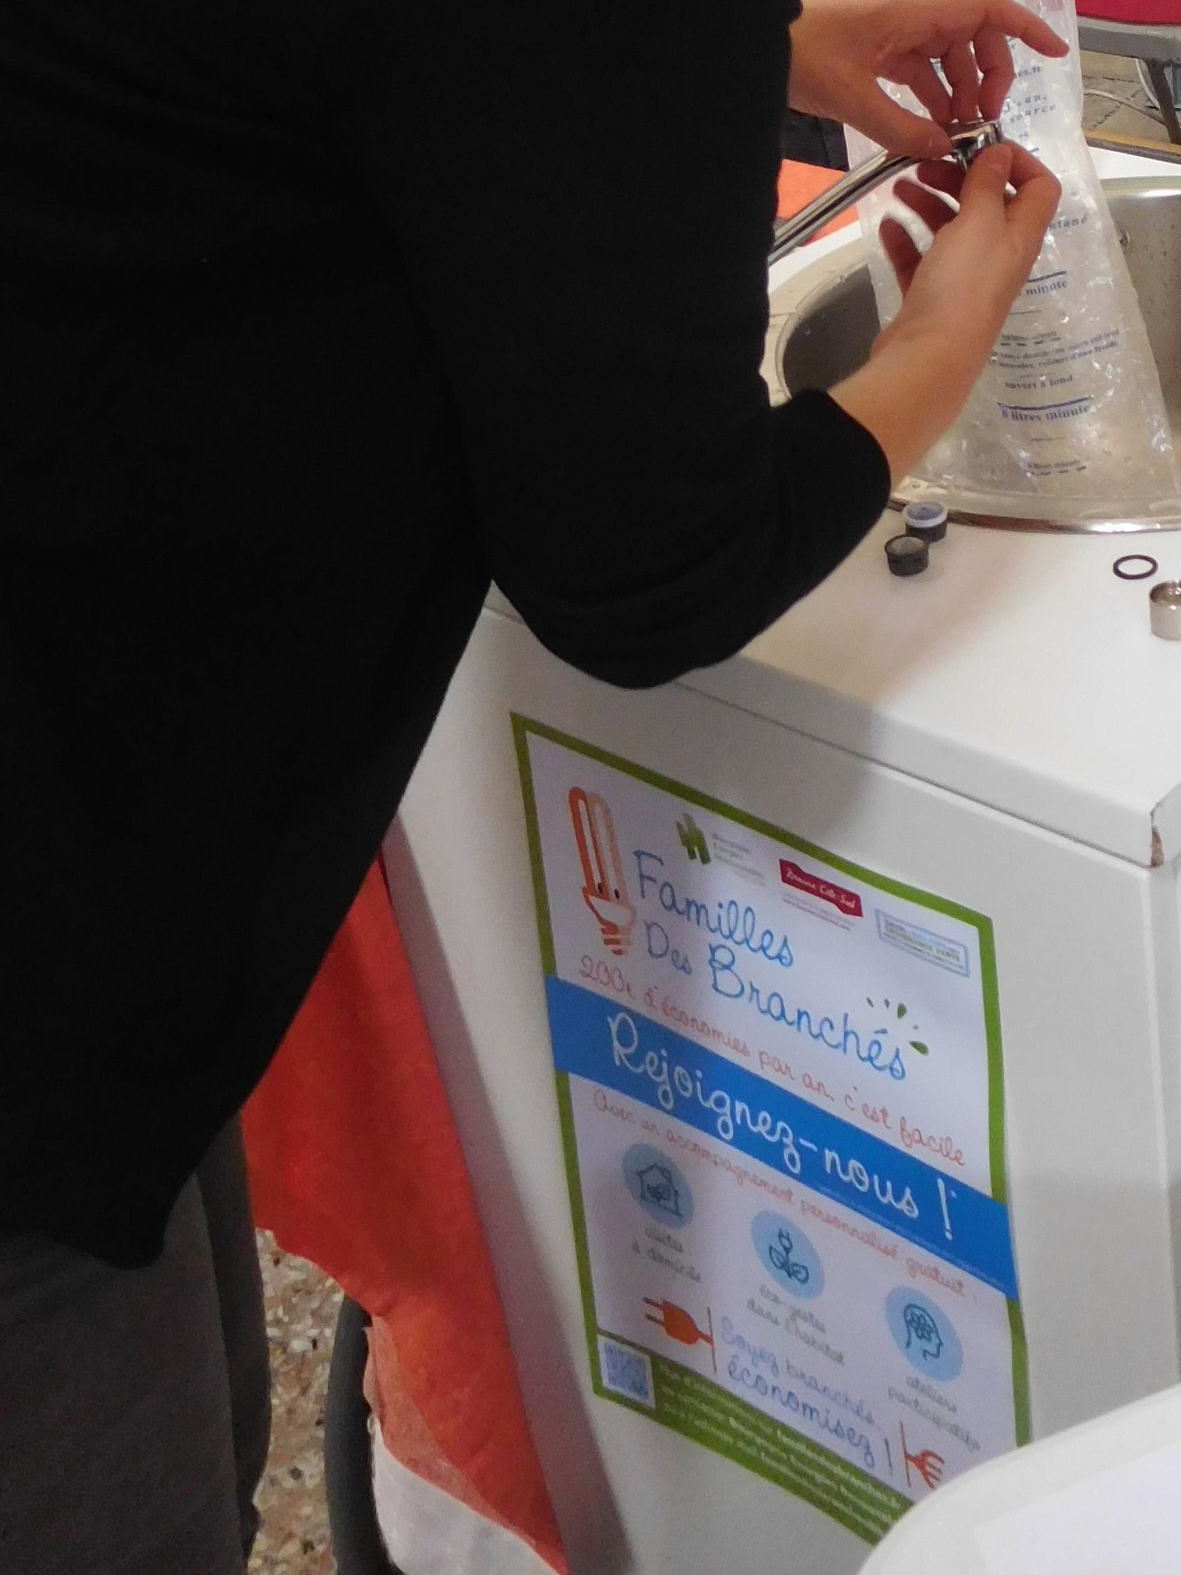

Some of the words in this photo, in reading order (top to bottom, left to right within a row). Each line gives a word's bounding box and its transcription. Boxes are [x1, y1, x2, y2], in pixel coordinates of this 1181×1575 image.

[632, 847, 795, 968] Familles
[642, 920, 693, 976] Des
[707, 941, 908, 1082] Branchés
[759, 1049, 797, 1084] par
[897, 1114, 967, 1168] facile
[727, 1353, 876, 1469] économisez
